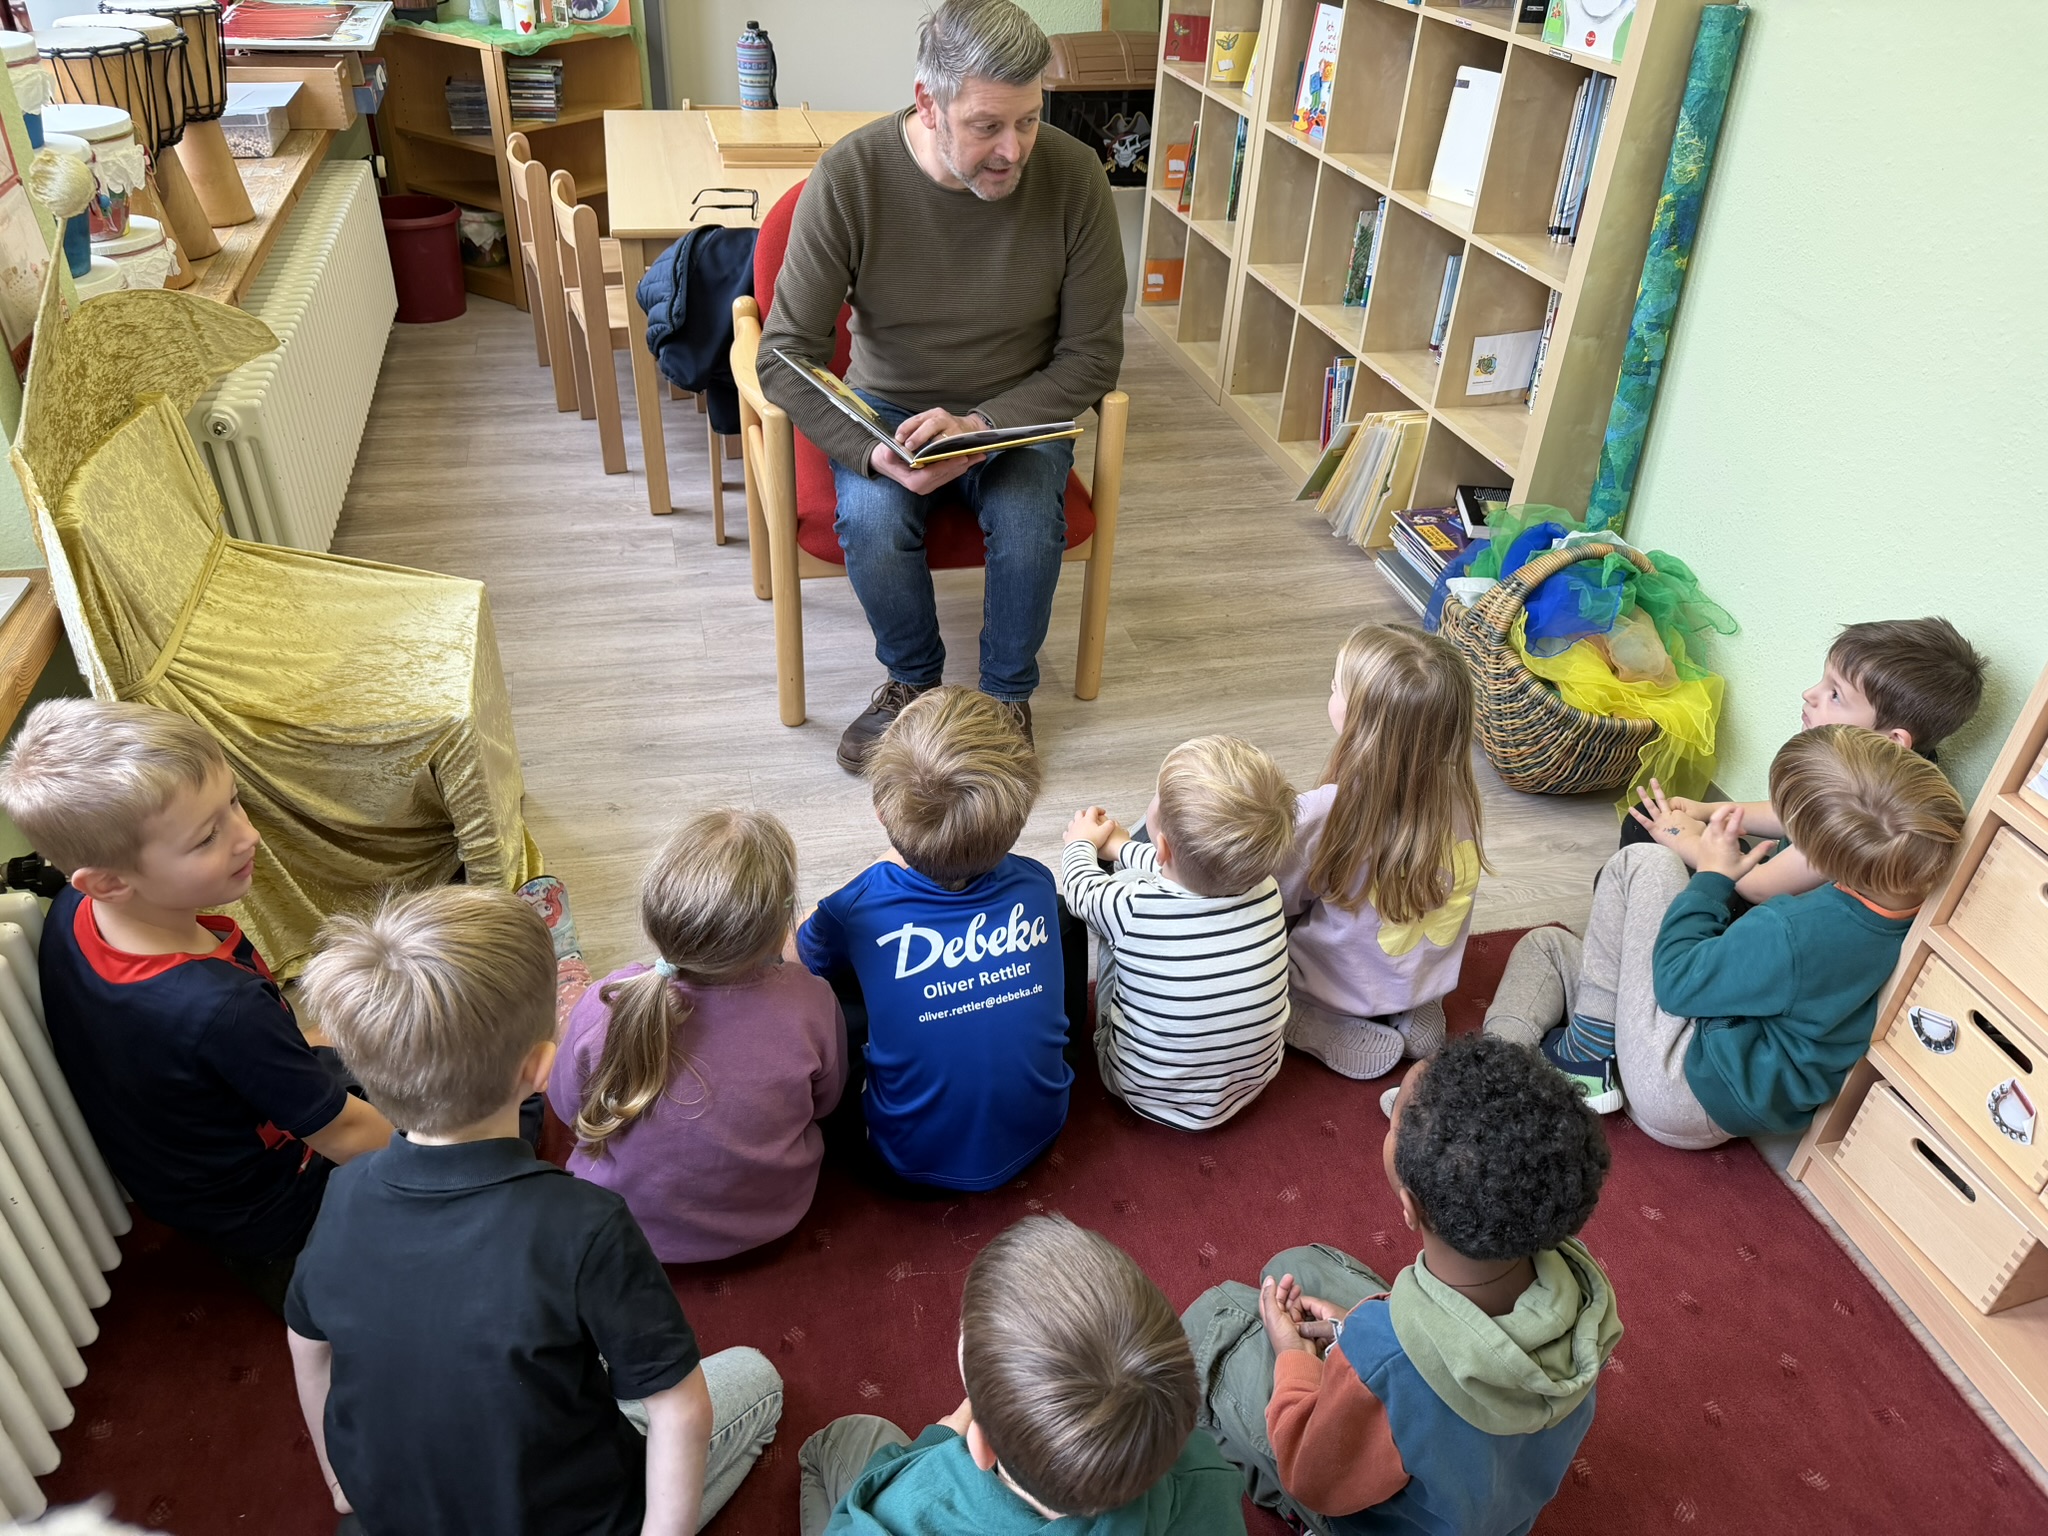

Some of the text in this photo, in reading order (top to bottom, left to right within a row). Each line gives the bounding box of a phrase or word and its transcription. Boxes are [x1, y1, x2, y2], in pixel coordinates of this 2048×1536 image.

[876, 902, 1048, 980] Debeka
[924, 962, 1031, 999] Oliver Rettler
[919, 984, 1043, 1023] oliver.rettler@debeka.de
